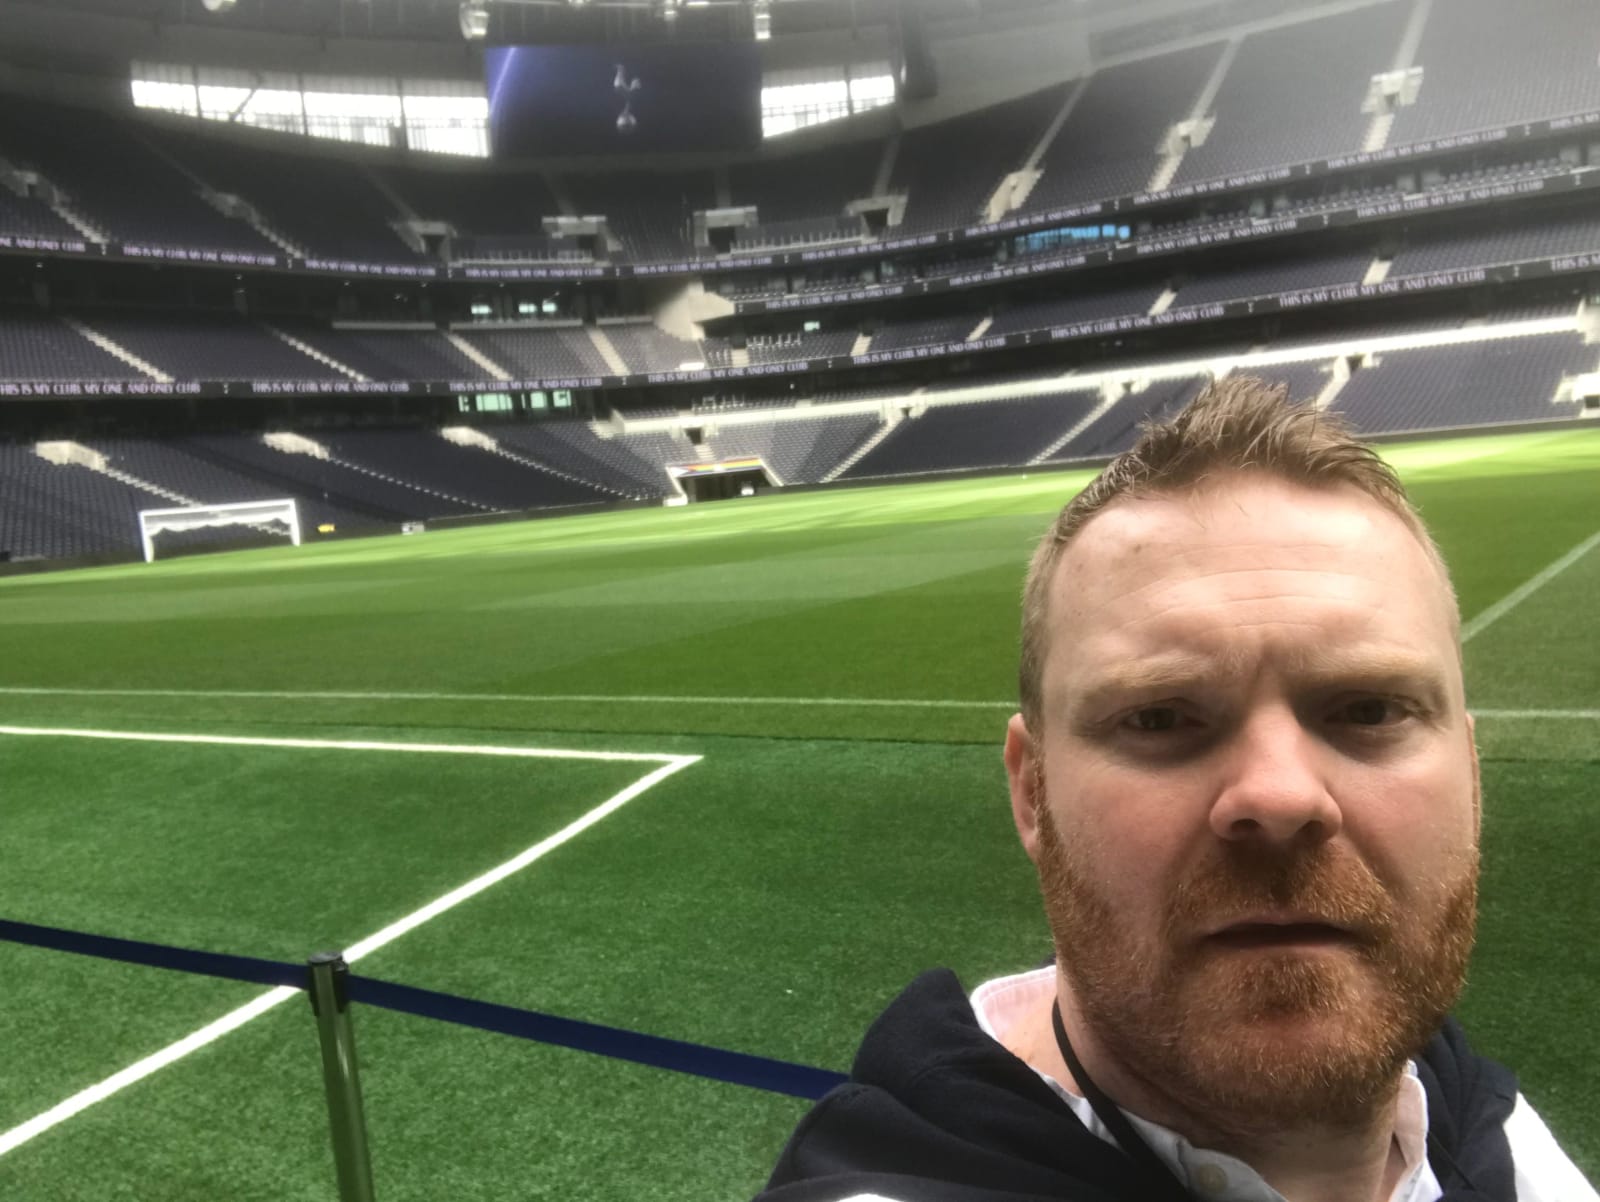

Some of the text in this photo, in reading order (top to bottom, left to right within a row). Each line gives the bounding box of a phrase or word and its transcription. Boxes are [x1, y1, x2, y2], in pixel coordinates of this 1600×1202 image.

[1280, 294, 1300, 308] THIS
[1301, 293, 1313, 305] IS
[1314, 291, 1328, 303] MY
[1360, 284, 1376, 297] MY
[1379, 281, 1400, 294] ONE
[1404, 278, 1425, 291] AND
[1428, 274, 1454, 288] ONLY
[1457, 270, 1485, 284] CLUB
